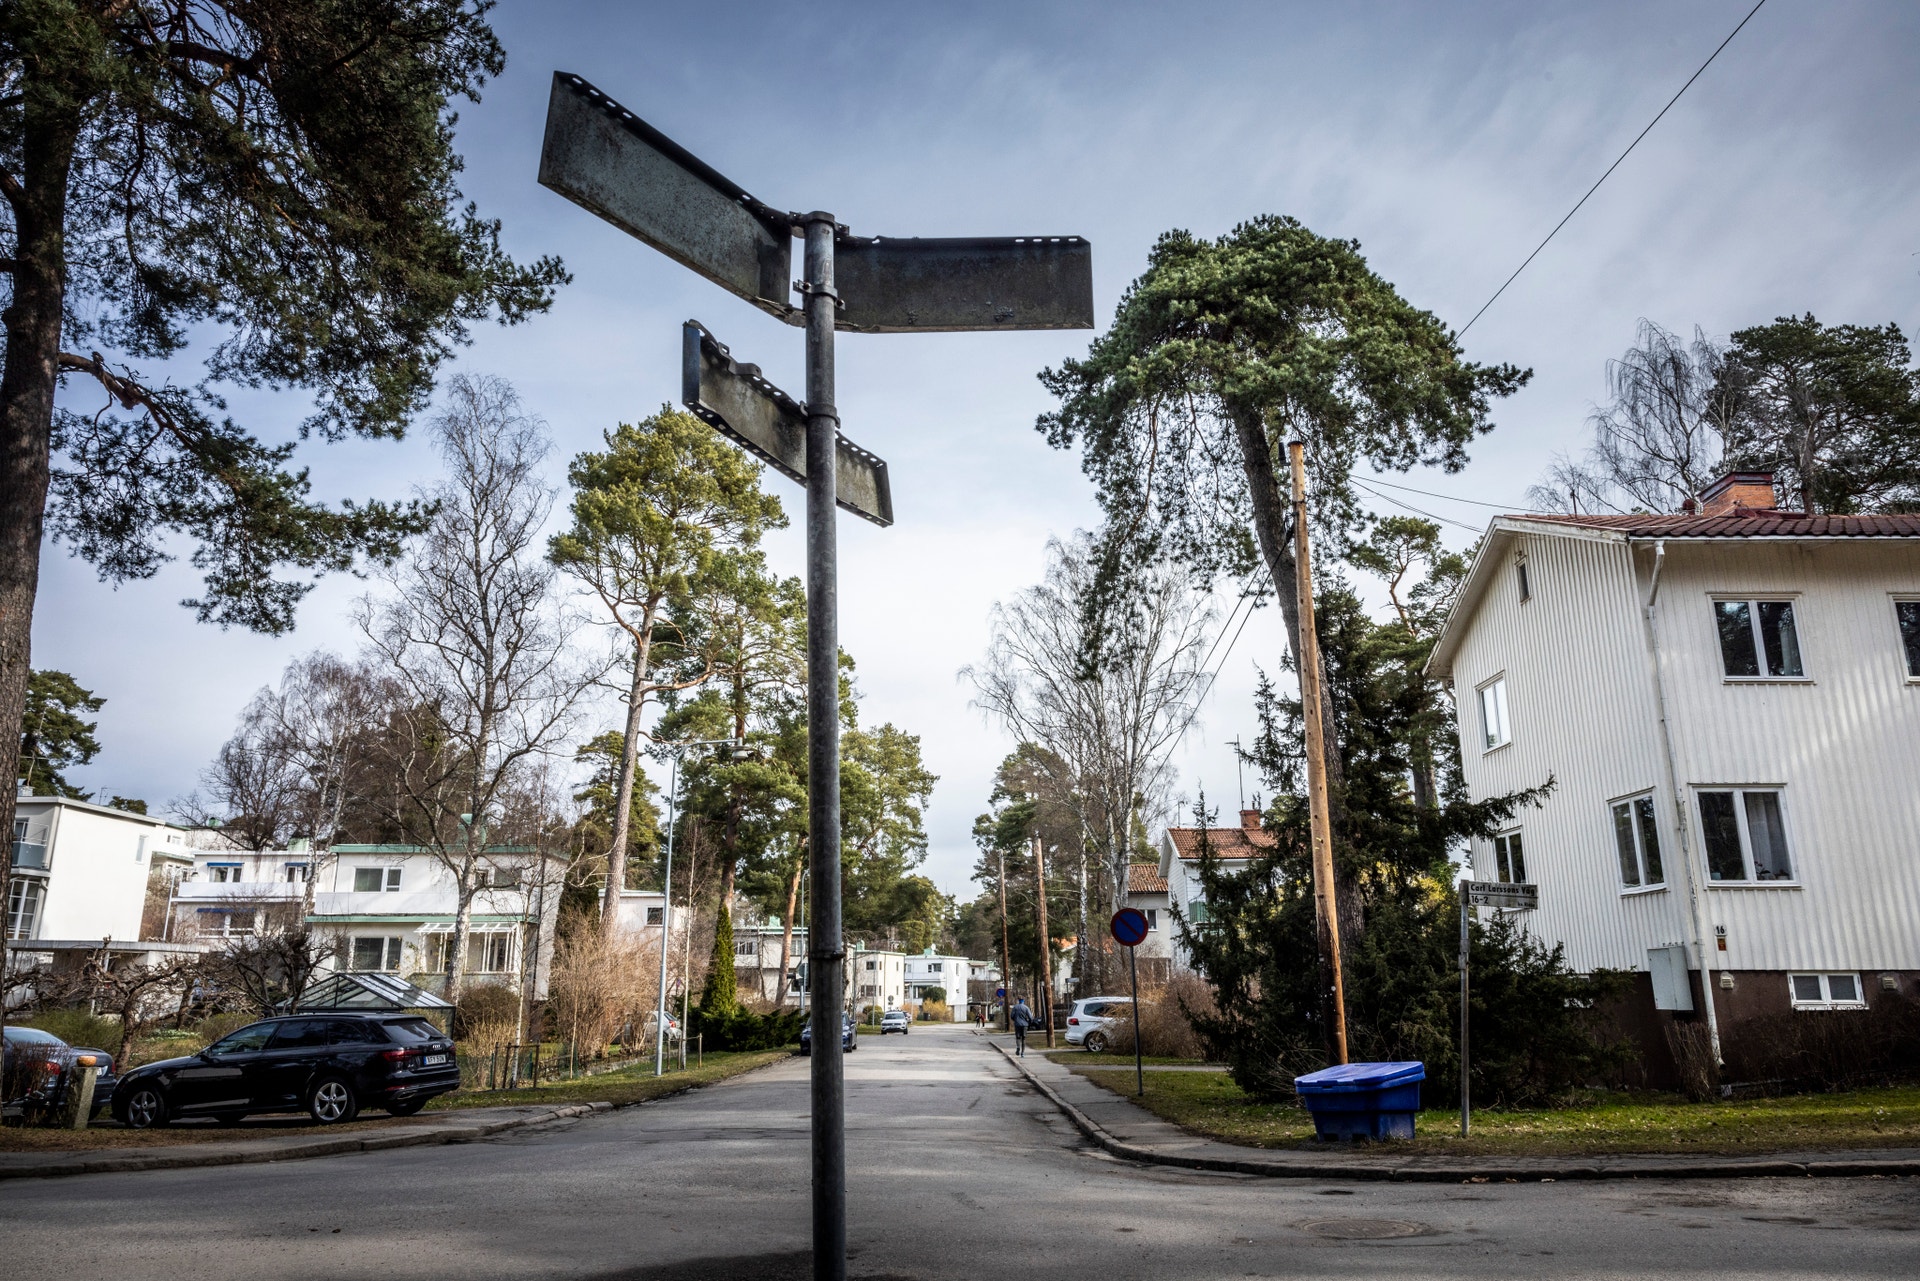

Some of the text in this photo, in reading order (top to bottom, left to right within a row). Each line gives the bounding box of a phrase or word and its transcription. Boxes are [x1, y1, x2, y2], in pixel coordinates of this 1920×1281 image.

[1470, 884, 1485, 892] Carl
[1488, 885, 1519, 894] Larssons
[1471, 895, 1488, 904] 16-2
[1716, 925, 1725, 935] 16
